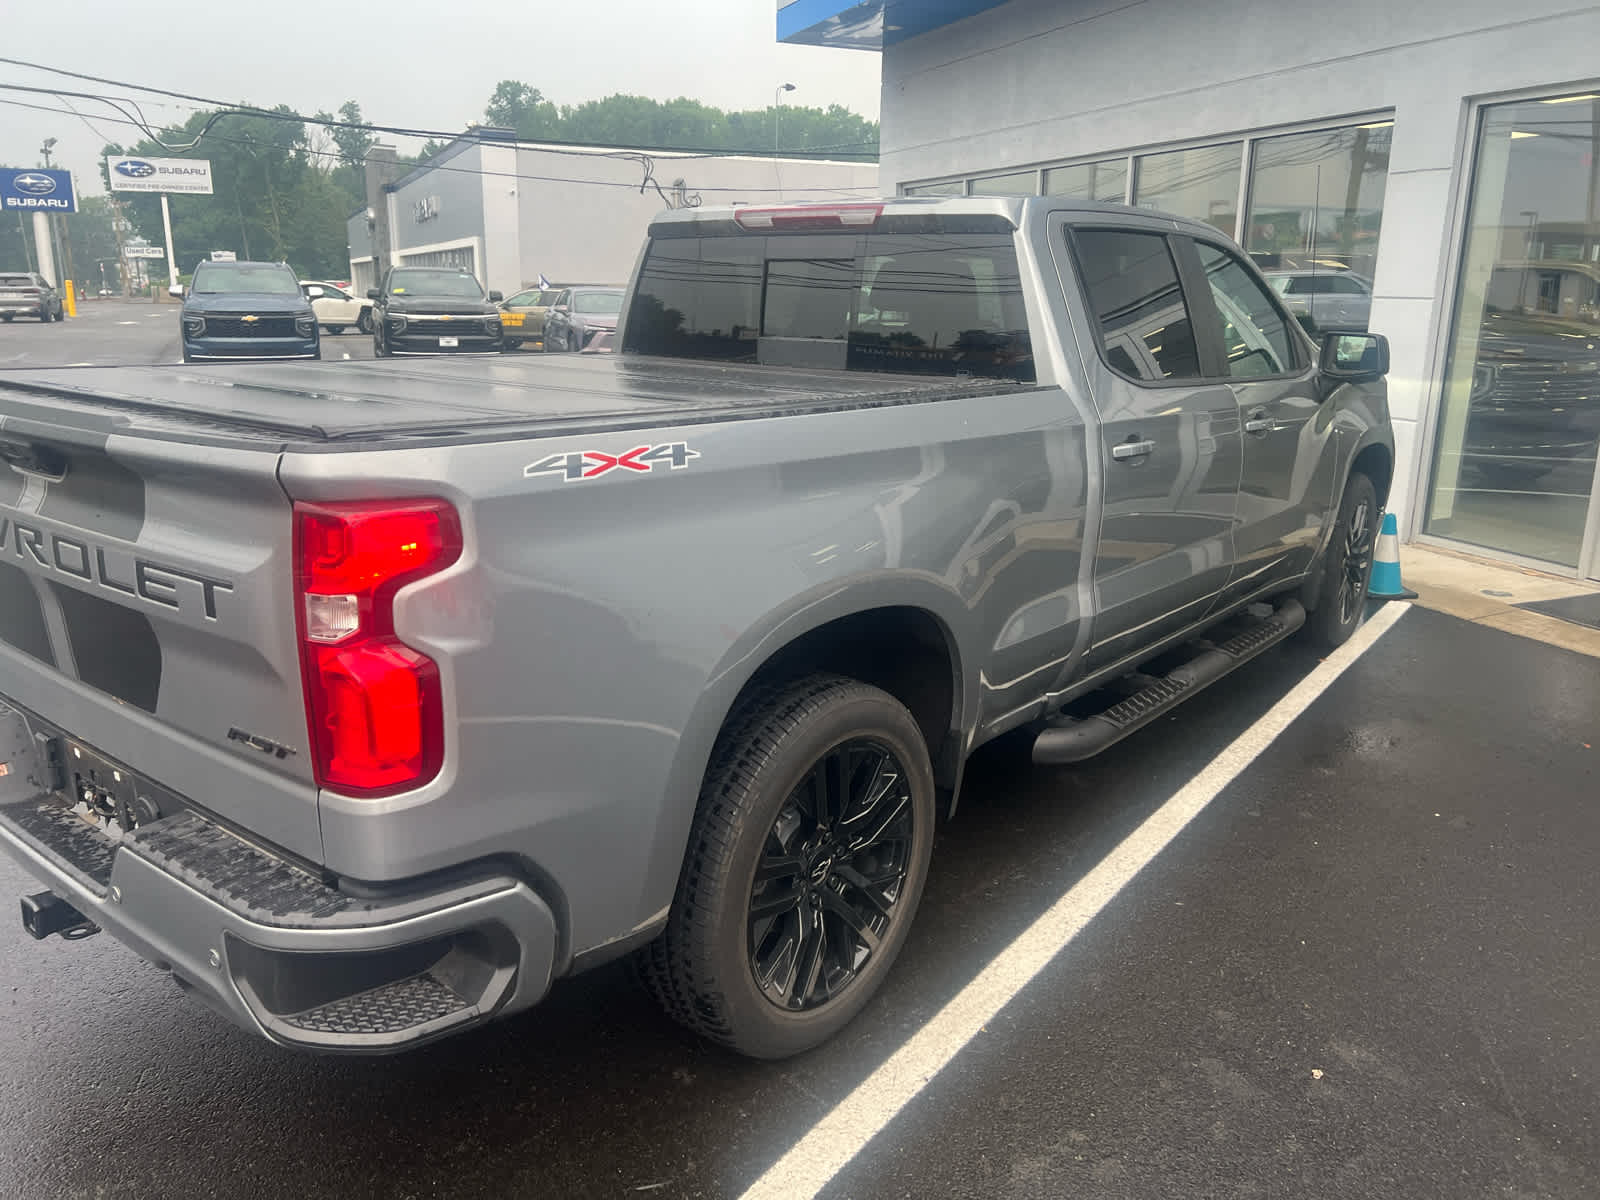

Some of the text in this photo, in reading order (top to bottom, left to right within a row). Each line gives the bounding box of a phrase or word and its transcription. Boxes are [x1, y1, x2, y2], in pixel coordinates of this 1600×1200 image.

[158, 166, 207, 176] SUBARU
[7, 197, 69, 208] SUBARU
[126, 247, 145, 255] Used
